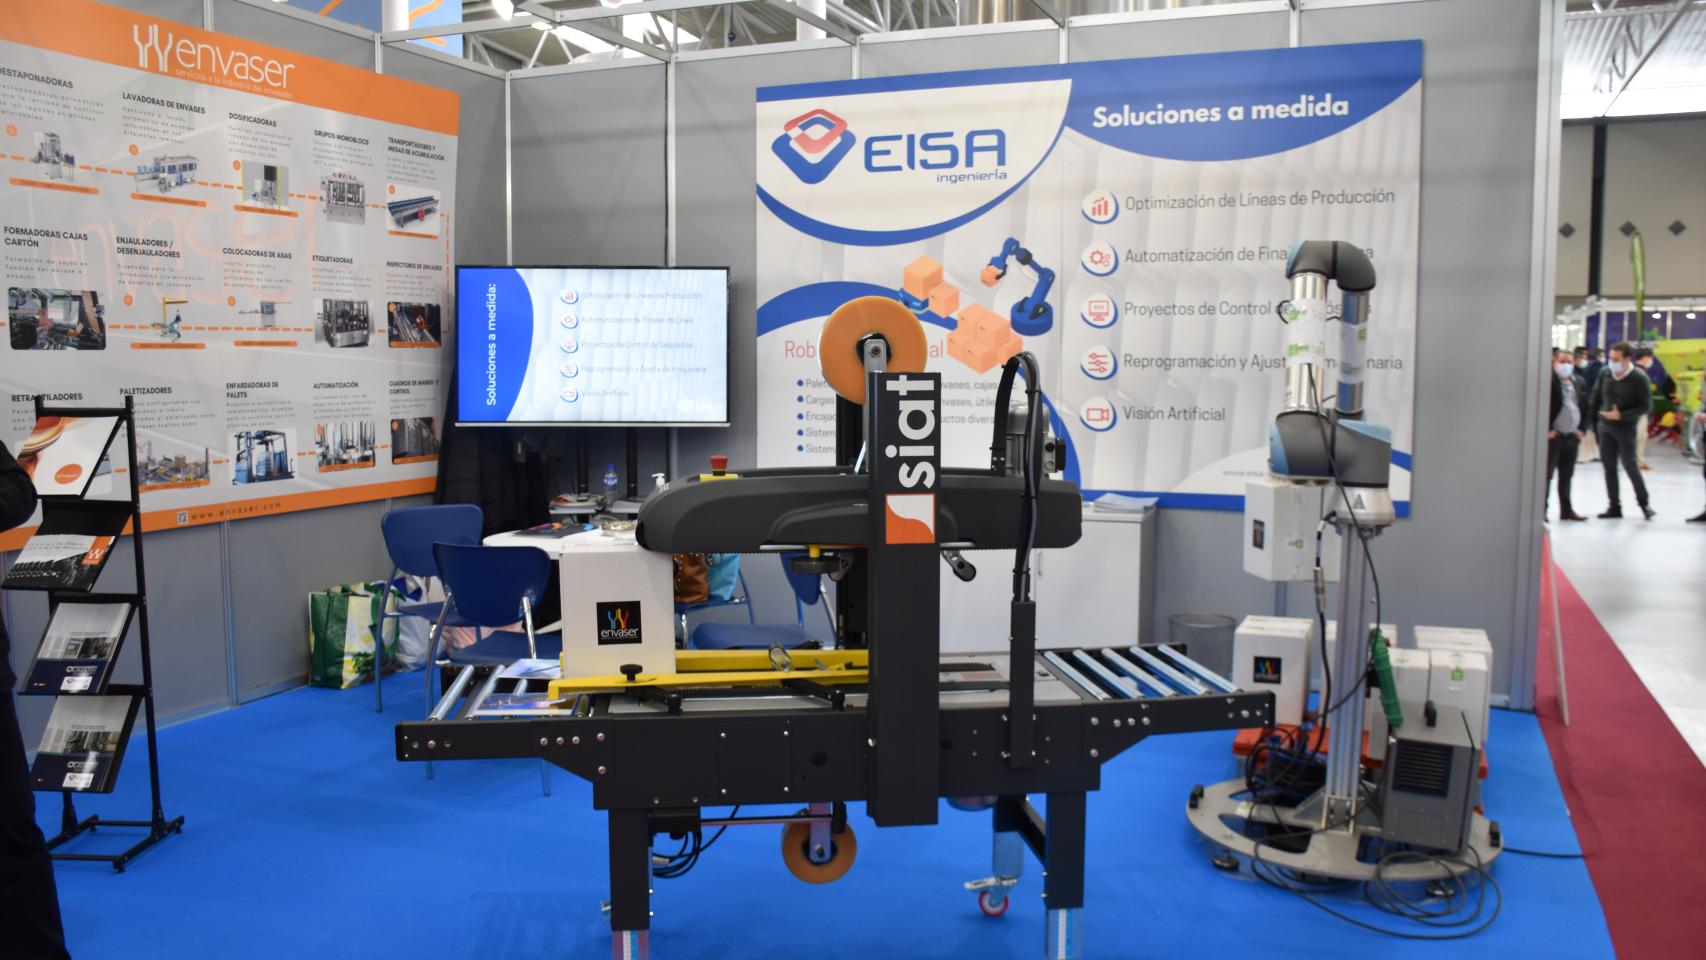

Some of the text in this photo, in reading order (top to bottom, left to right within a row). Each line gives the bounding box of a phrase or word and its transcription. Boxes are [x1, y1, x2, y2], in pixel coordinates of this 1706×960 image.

[176, 39, 296, 88] envaser
[122, 92, 206, 114] LAVADORAS DE ENVASES
[1092, 93, 1349, 128] Soluciones a medida
[229, 112, 277, 128] DOSIFICADORAS
[314, 130, 369, 146] GRUPOS MONOBLOCS
[388, 137, 432, 150] TRANSPORTADORES
[388, 146, 404, 154] MESAS
[412, 150, 444, 161] ACUMULACIÓN
[864, 128, 1006, 173] EISA
[936, 168, 1008, 184] ingeniería
[1125, 194, 1216, 212] Optimización
[1218, 193, 1236, 208] de
[1289, 190, 1308, 206] de
[1312, 188, 1396, 204] Producción
[4, 226, 88, 240] FORMADORAS CAJAS
[4, 236, 39, 248] CARTÓN
[116, 236, 168, 248] ENJAULADORES
[116, 247, 180, 258] DESENJAULADORES
[222, 248, 268, 258] COLOCADORAS
[312, 254, 353, 264] ETIQUETADORAS
[1124, 246, 1234, 262] Automatización
[1237, 246, 1255, 261] de
[386, 261, 417, 270] INSPECTORES
[486, 284, 496, 331] medida:
[1124, 301, 1196, 318] Proyectos
[1198, 301, 1216, 316] de
[1219, 300, 1271, 316] Control
[1124, 354, 1236, 372] Reprogramación
[1240, 358, 1248, 372] y
[1250, 354, 1286, 372] Ajust
[486, 342, 496, 406] Soluciones
[120, 386, 172, 395] PALETIZADORES
[314, 381, 358, 389] AUTOMATIZACIÓN
[12, 393, 83, 402] RETRATILADORES
[806, 394, 835, 406] Cargas
[1122, 406, 1226, 421] Visión Artificial
[885, 375, 936, 489] siat
[600, 628, 639, 638] envaser
